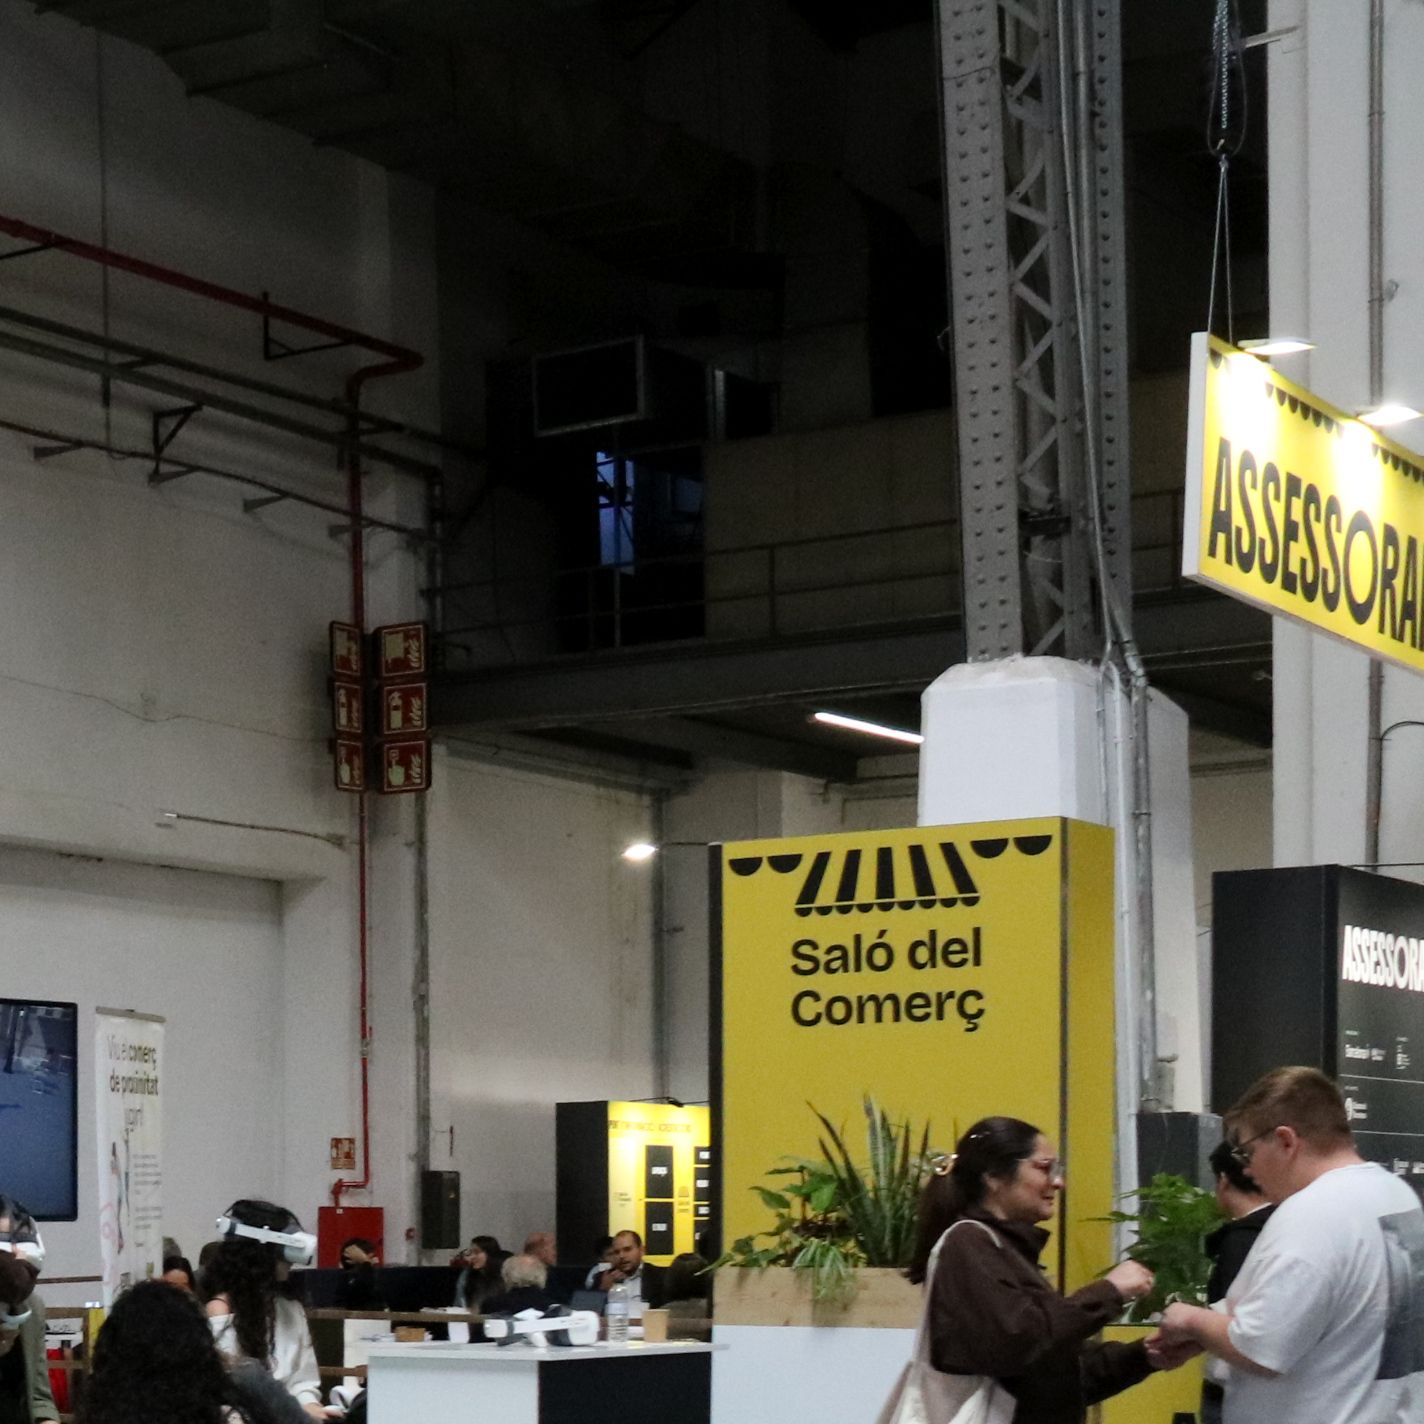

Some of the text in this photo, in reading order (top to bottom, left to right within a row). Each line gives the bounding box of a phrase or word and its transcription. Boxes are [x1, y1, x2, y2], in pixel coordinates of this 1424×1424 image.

[1208, 436, 1424, 653] ASSESSORA
[790, 926, 982, 976] Saló del
[791, 989, 986, 1033] Comerç
